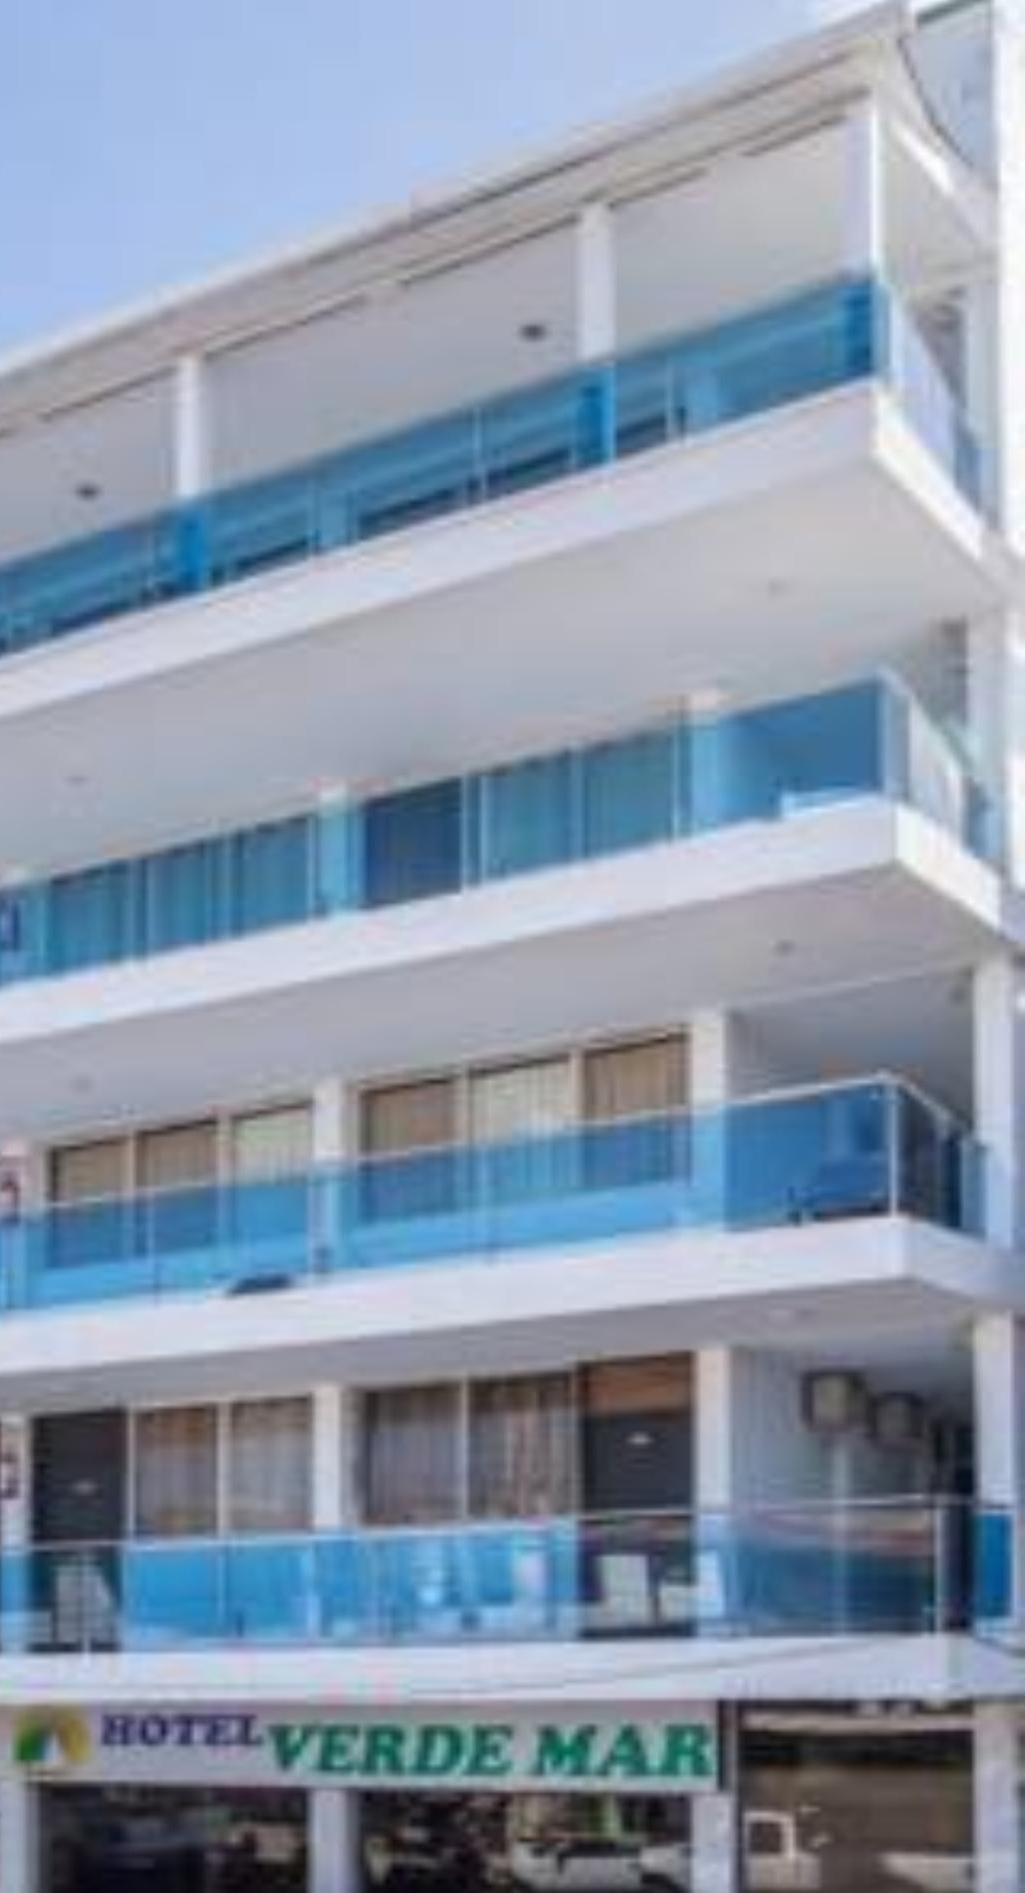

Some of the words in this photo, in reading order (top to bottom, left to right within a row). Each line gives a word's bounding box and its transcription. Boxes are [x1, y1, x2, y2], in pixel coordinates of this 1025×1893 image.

[102, 1714, 263, 1747] HOTEL
[269, 1724, 513, 1775] VERDE
[529, 1723, 713, 1776] MAR
